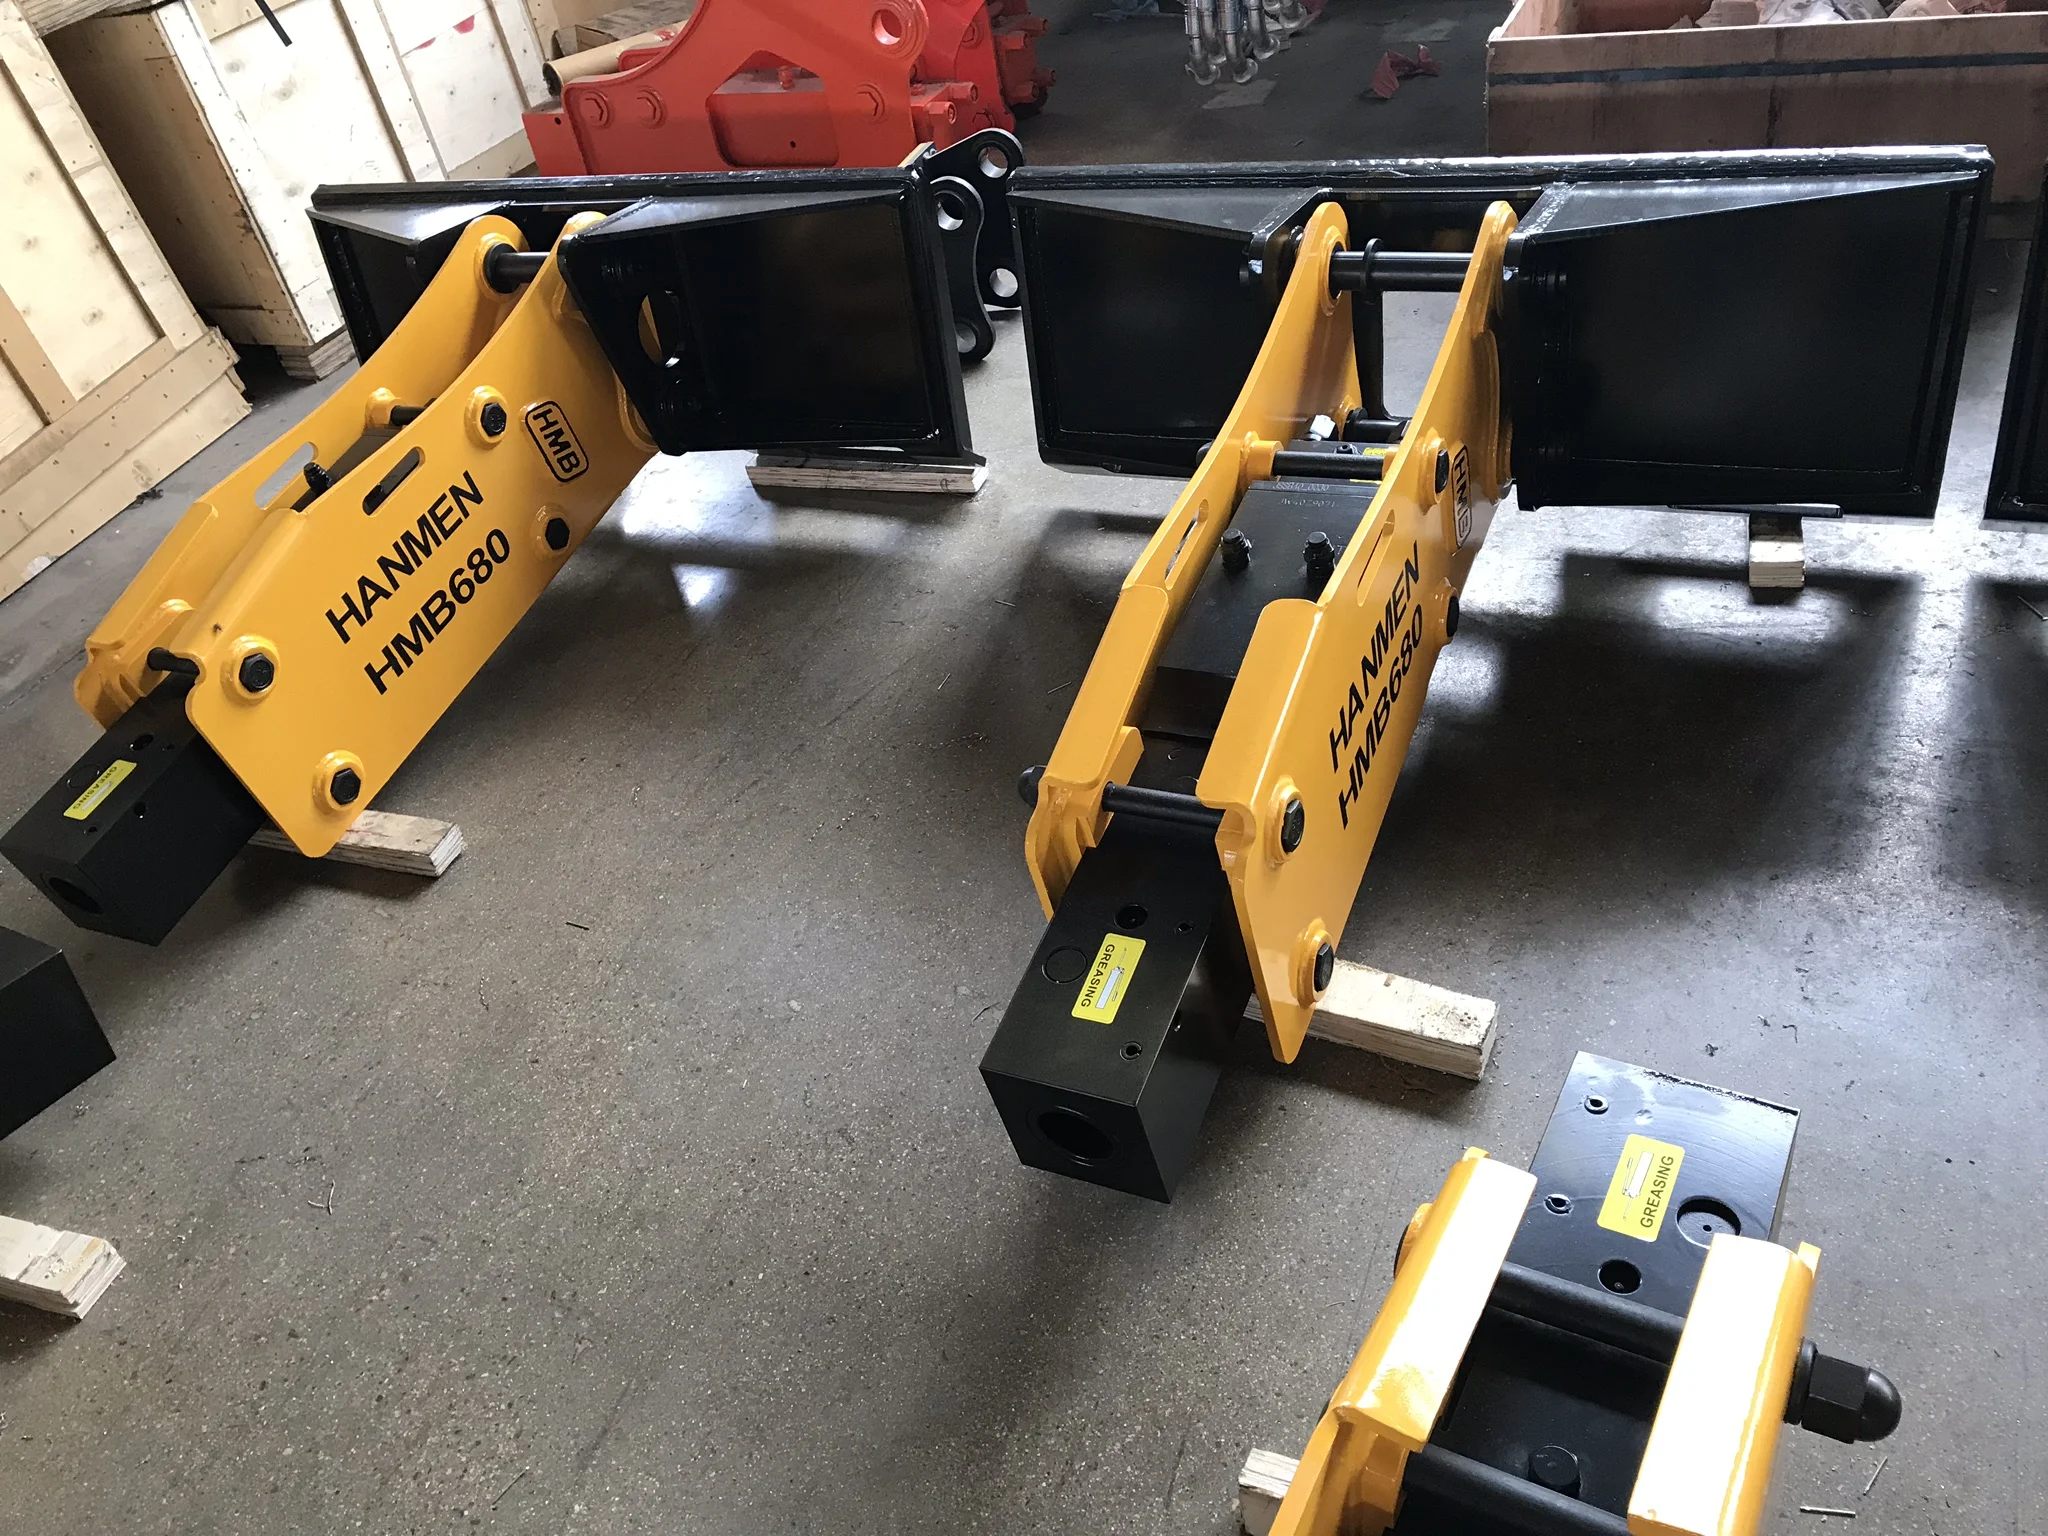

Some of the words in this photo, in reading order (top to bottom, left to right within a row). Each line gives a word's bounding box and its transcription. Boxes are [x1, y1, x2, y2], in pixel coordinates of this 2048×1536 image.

[532, 408, 581, 474] HMB
[1454, 455, 1469, 538] HMB
[325, 470, 484, 645] HANMEN
[364, 528, 510, 695] HMB680
[1329, 540, 1419, 773] HANMEN
[1338, 603, 1423, 830] HMB680
[1080, 944, 1115, 1008] GREASING
[1640, 1155, 1674, 1228] GREASING
